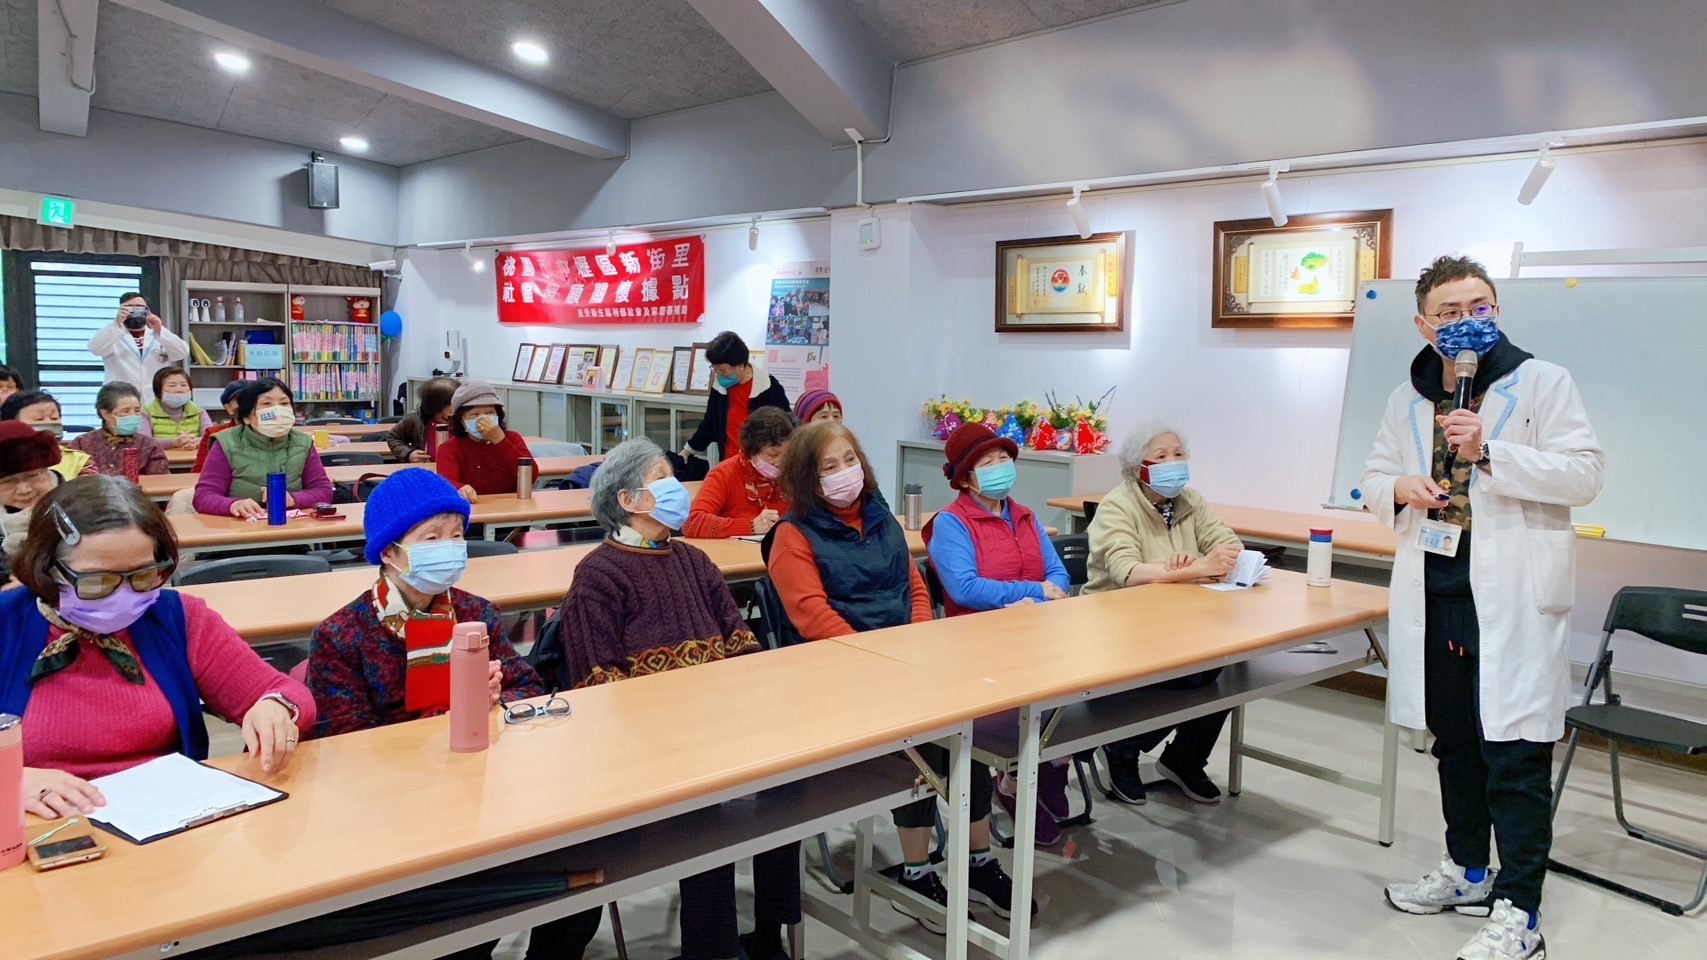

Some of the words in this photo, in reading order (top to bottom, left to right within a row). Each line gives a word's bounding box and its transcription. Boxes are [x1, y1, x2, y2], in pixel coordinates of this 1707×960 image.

[503, 243, 690, 278] 桃園壢區新街里
